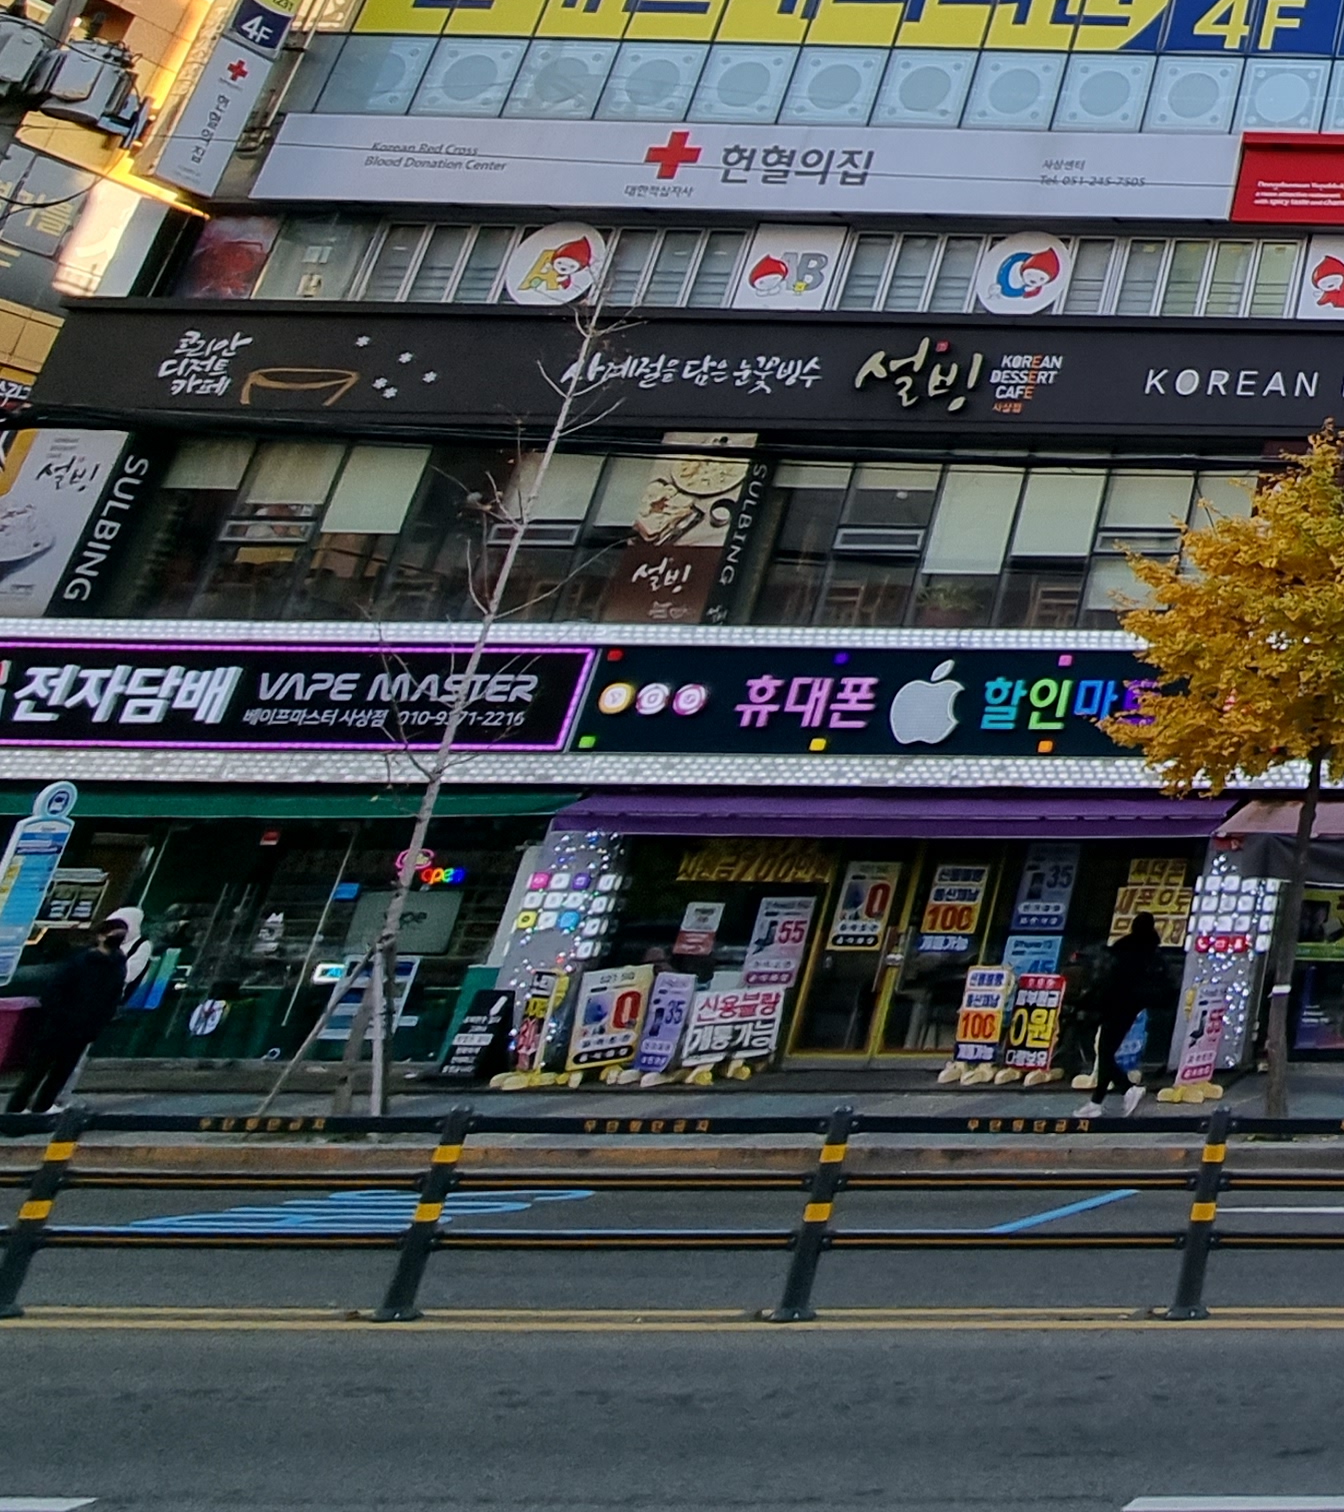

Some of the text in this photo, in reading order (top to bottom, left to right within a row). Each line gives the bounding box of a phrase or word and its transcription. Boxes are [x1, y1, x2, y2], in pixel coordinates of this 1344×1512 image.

[239, 14, 274, 44] 4F
[363, 154, 507, 172] Blood Donation Center
[720, 144, 872, 188] 헌혈의집
[157, 356, 230, 378] 디저트
[854, 336, 984, 413] 설빙
[989, 369, 1058, 385] DESSERT
[1001, 354, 1063, 370] KOREAN
[170, 377, 232, 396] 카페
[995, 384, 1035, 400] CAFE
[1143, 367, 1321, 398] KOREAN
[62, 451, 150, 603] SULBING
[716, 462, 770, 586] SULBING
[630, 549, 693, 595] 설빙
[12, 664, 243, 725] 전자담배
[257, 672, 540, 705] VAPE MASTER
[733, 674, 879, 730] 휴대폰
[242, 707, 337, 727] 베이프마스터
[697, 989, 782, 1022] 신용불량
